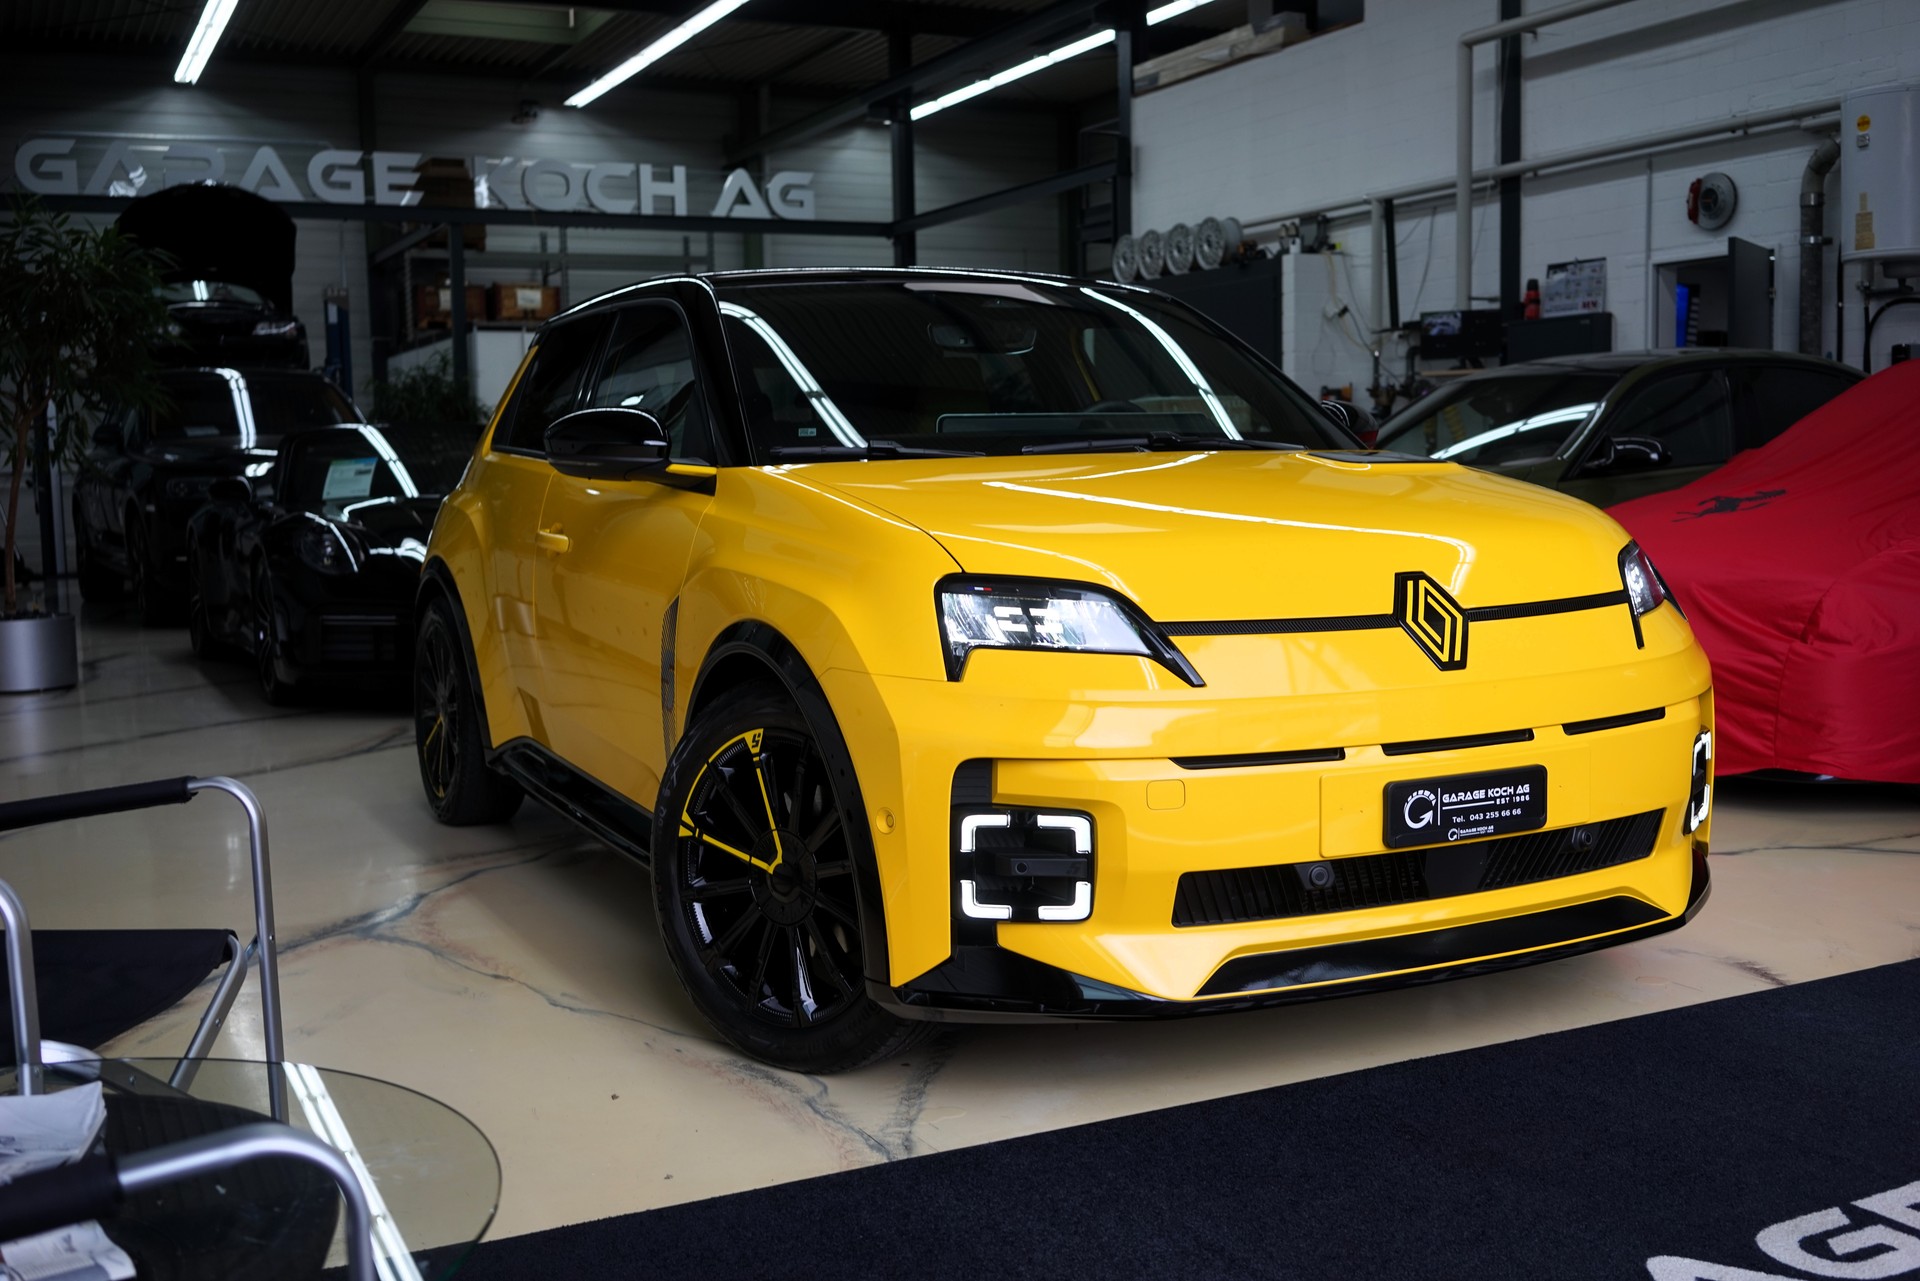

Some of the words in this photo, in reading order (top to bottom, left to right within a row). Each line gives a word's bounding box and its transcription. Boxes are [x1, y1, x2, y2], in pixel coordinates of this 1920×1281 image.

[14, 138, 426, 207] GARAGE
[473, 155, 689, 217] KOCH
[710, 166, 815, 221] AG
[1442, 789, 1486, 803] GARAGE
[1487, 786, 1514, 798] KOCH
[1516, 784, 1530, 794] AG
[1496, 797, 1510, 805] EST
[1512, 794, 1530, 803] 1986
[1452, 815, 1466, 823] Tel.
[1469, 813, 1484, 821] 043
[1485, 811, 1500, 819] 255
[1501, 809, 1511, 817] 66
[1512, 808, 1522, 816] 66
